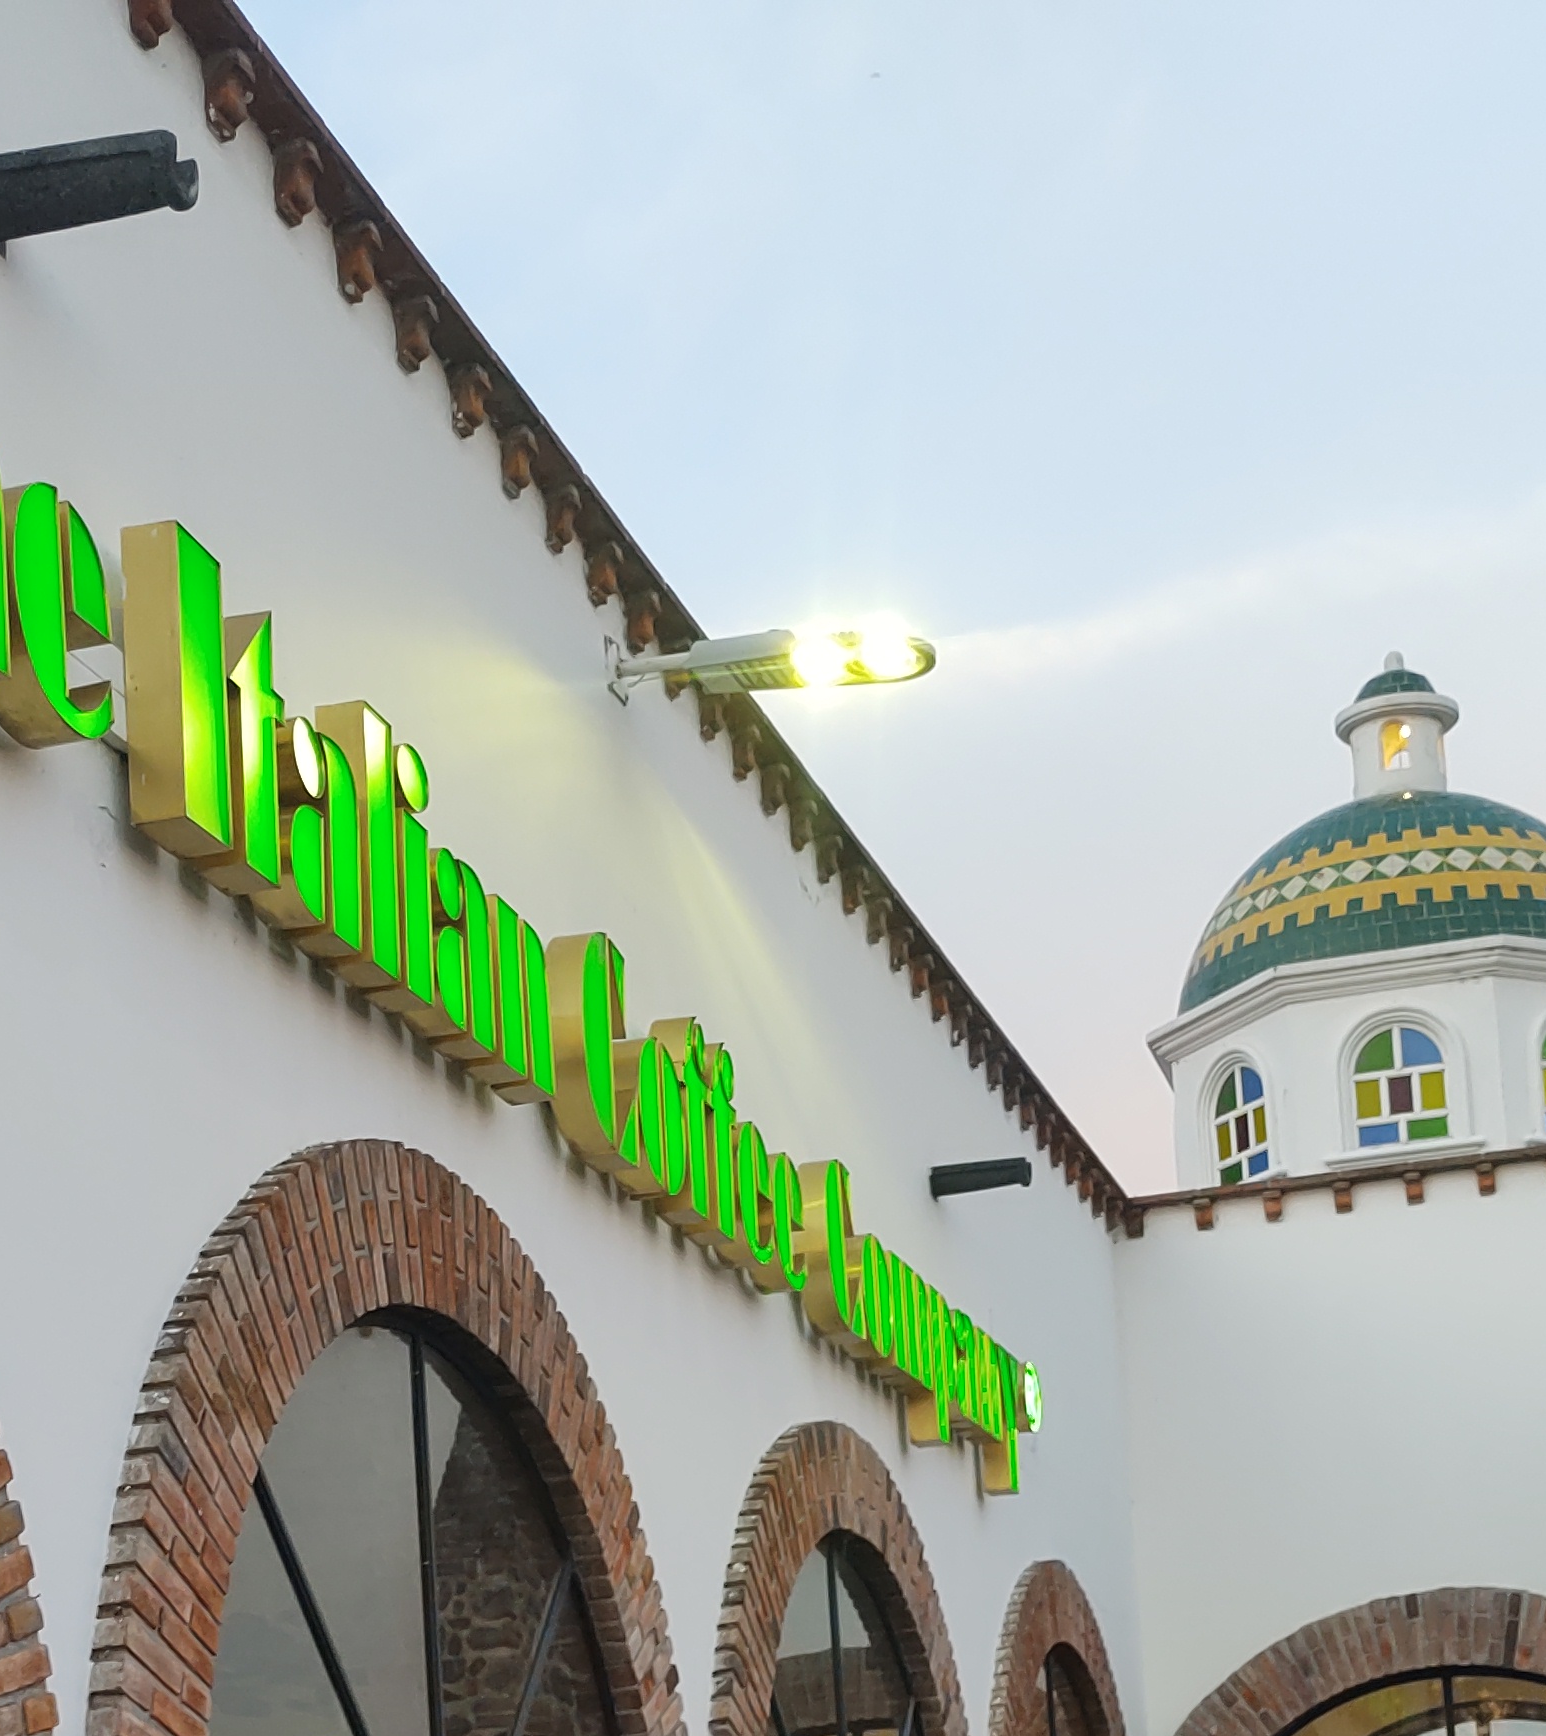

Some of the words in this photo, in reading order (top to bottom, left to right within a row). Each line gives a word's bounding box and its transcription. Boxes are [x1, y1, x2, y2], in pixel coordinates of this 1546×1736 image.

[169, 521, 555, 1099] Italian
[575, 931, 808, 1293] Coffee
[821, 1159, 1021, 1493] Company
